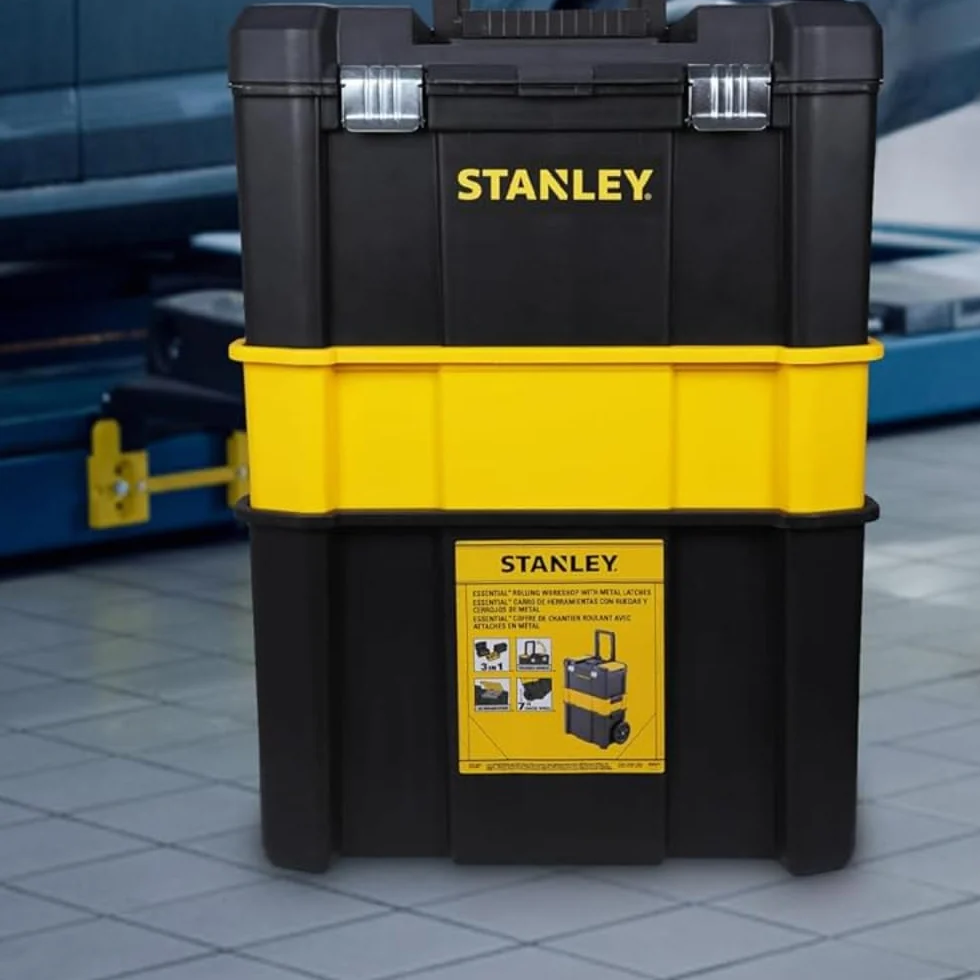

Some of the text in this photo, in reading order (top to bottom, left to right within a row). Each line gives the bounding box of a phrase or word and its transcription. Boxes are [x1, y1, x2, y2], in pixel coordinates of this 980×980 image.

[457, 168, 654, 201] STANLEY
[501, 555, 618, 573] STANLEY
[480, 662, 487, 670] 3
[497, 662, 503, 670] 1
